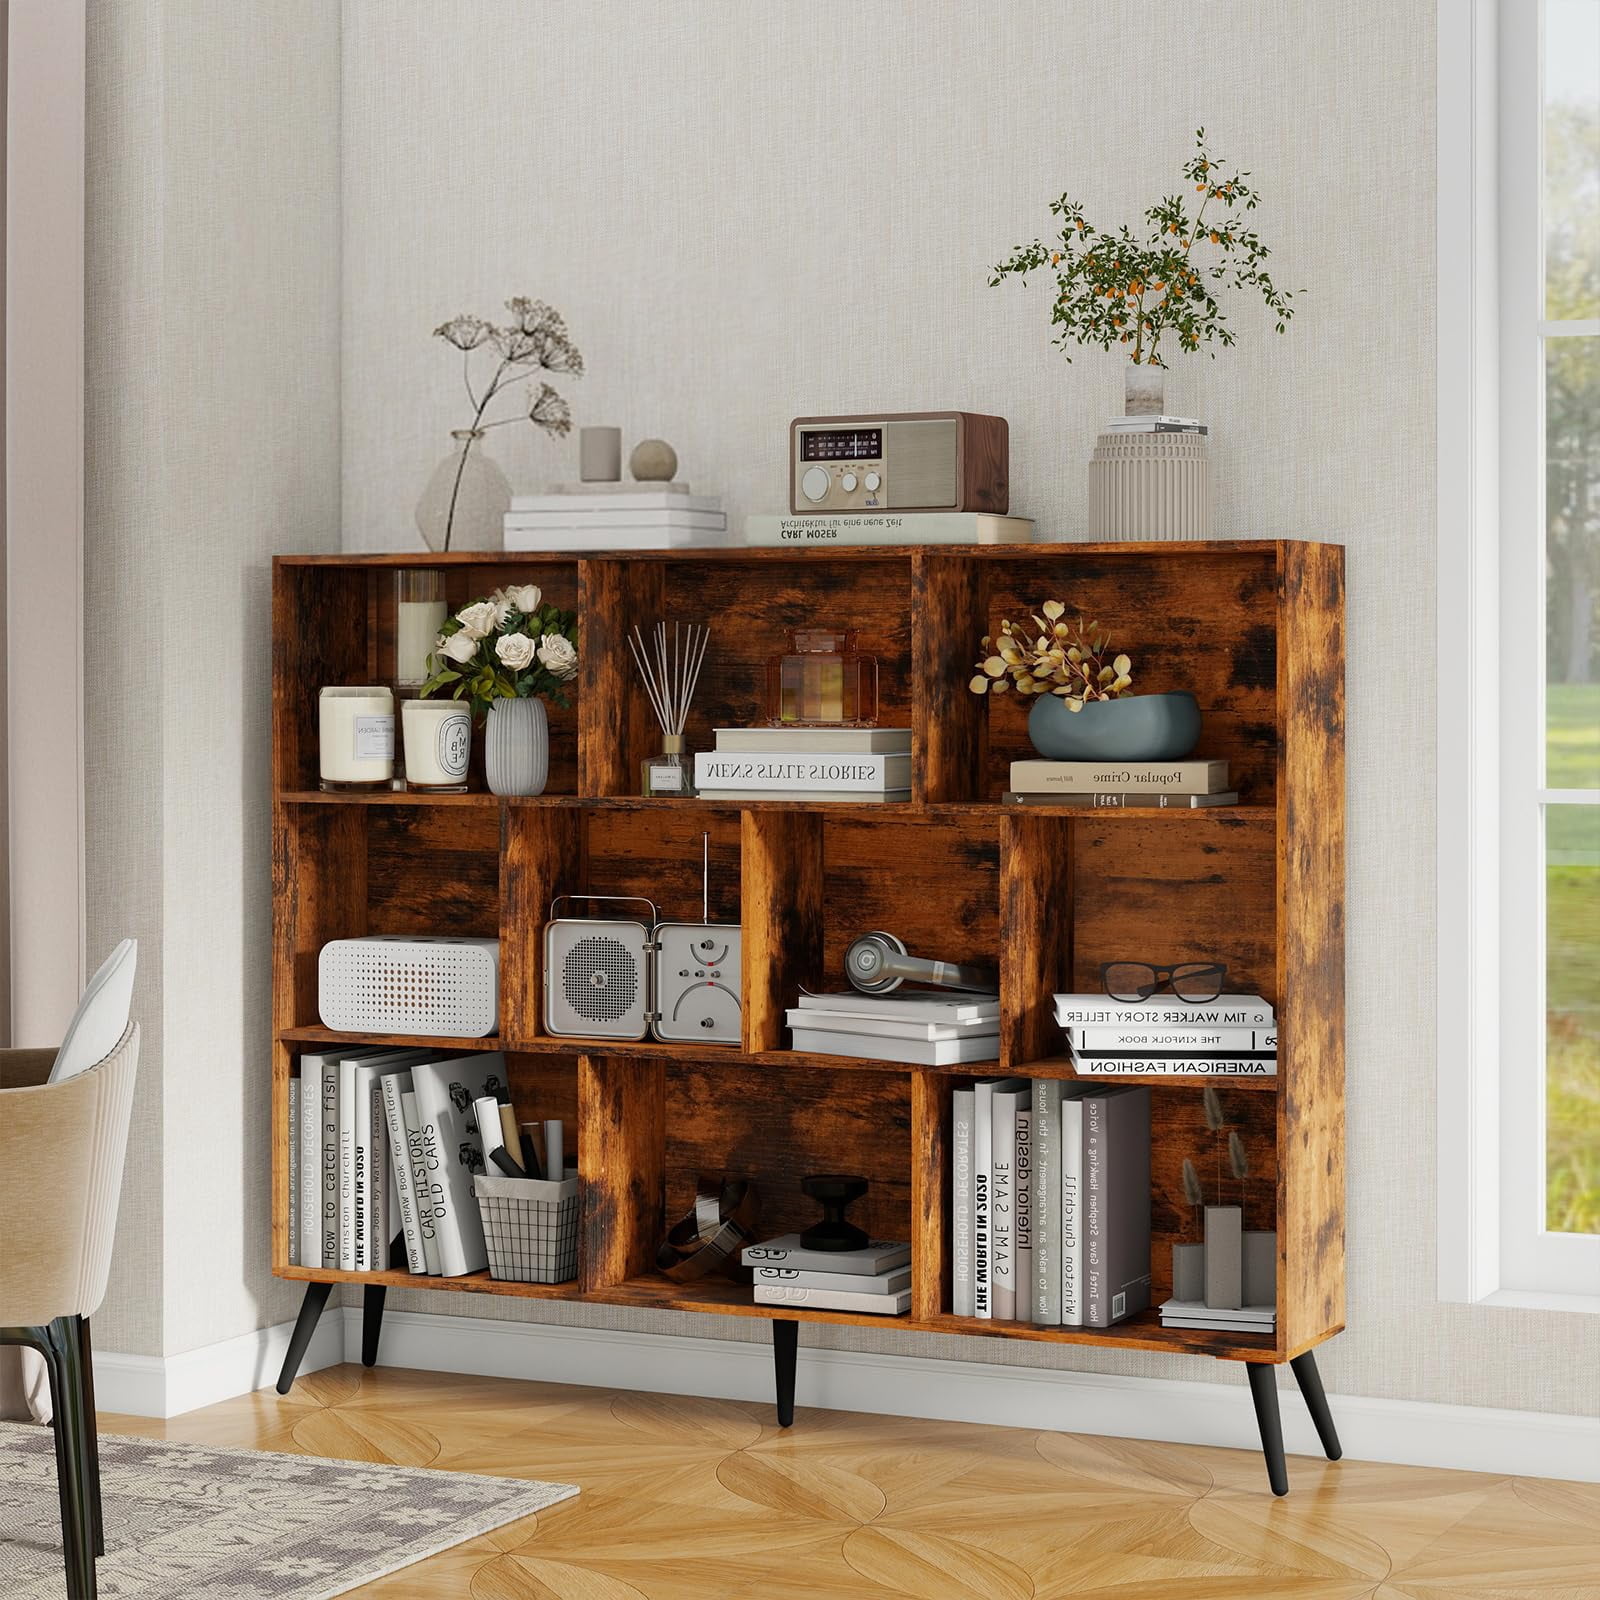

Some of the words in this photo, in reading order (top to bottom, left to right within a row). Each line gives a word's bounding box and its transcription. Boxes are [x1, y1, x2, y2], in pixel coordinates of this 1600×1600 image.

[324, 1074, 336, 1113] fish
[384, 1079, 400, 1132] children
[303, 1084, 316, 1156] DECORATES
[326, 1123, 336, 1133] a
[372, 1092, 381, 1140] Isaacson
[341, 1129, 350, 1199] Churchill
[392, 1139, 403, 1157] for
[407, 1128, 430, 1199] HISTORY
[421, 1123, 439, 1171] CARS
[324, 1143, 336, 1192] catch
[372, 1146, 380, 1183] Walter
[397, 1164, 407, 1190] Book
[303, 1162, 316, 1236] HOUSEHOLD
[324, 1201, 336, 1219] to
[372, 1189, 382, 1201] by
[401, 1196, 413, 1223] DRAW
[430, 1183, 447, 1219] OLD
[341, 1206, 350, 1261] Winston
[372, 1206, 380, 1231] Jobs
[406, 1229, 416, 1241] TO
[420, 1208, 436, 1240] CAR
[324, 1231, 336, 1260] How
[372, 1236, 380, 1267] Steve
[409, 1248, 419, 1269] HOW
